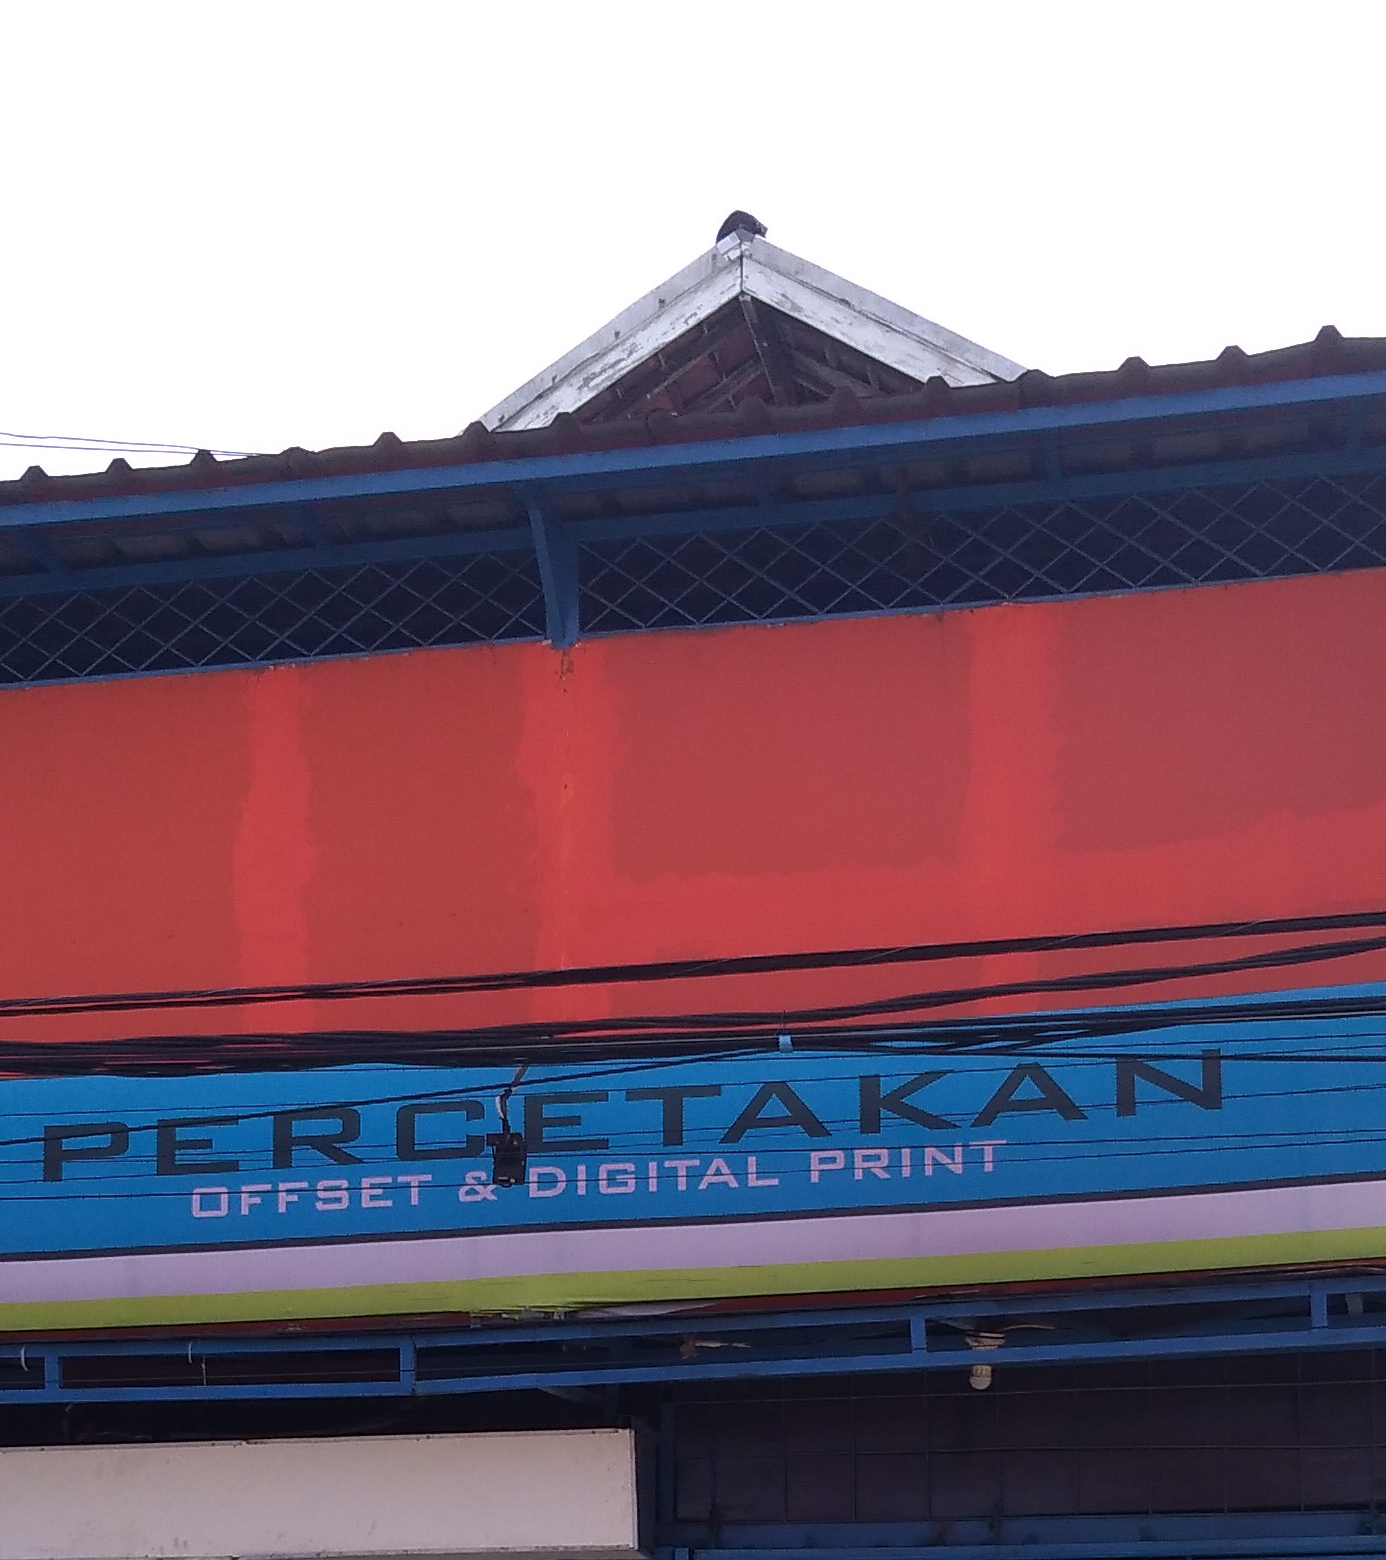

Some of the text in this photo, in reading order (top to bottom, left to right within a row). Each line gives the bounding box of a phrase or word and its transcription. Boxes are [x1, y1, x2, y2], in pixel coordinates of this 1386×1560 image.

[43, 1049, 1222, 1182] PERCETAKAN
[192, 1139, 1007, 1219] OFFSET & DIGITAL PRINT
